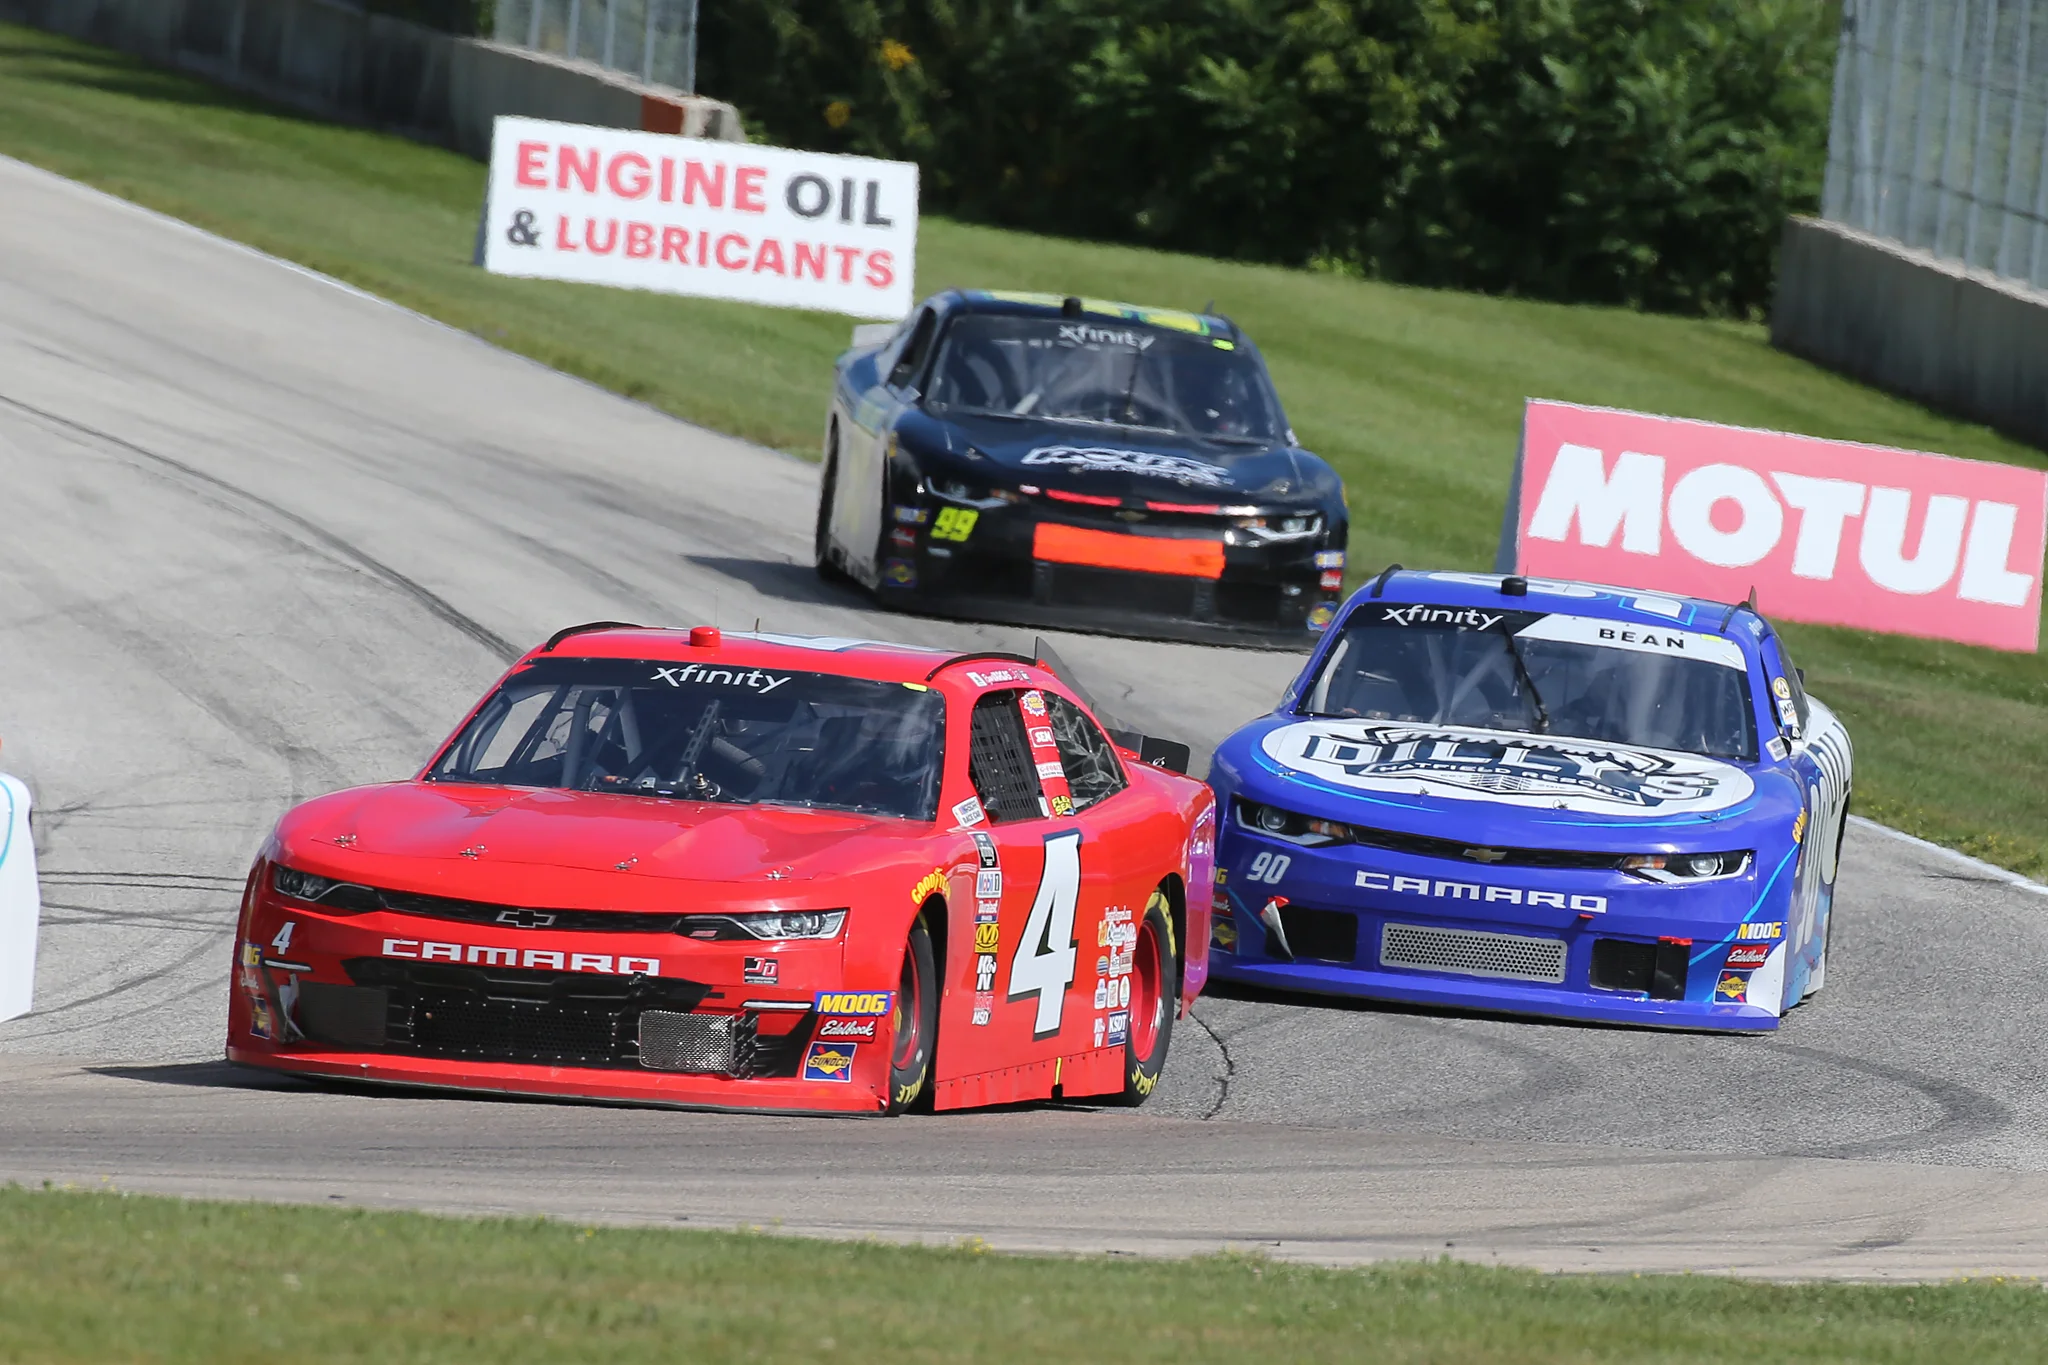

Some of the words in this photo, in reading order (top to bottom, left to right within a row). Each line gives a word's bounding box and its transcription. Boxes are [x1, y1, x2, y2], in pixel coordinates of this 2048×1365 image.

[515, 140, 767, 213] ENGINE
[786, 173, 894, 227] OIL
[506, 209, 541, 247] &
[556, 214, 895, 289] LUBRICANTS
[1058, 323, 1156, 351] xfinity
[930, 506, 980, 542] 99
[1527, 442, 2034, 607] MOTUL
[1381, 604, 1504, 631] xfinity
[1598, 627, 1686, 650] BEAN
[650, 663, 791, 694] xfinity
[1378, 762, 1512, 775] HATFIELD
[1521, 771, 1631, 798] RESORT
[1246, 851, 1292, 884] 90
[1354, 870, 1608, 914] CAMARO
[271, 921, 296, 955] 4
[1008, 830, 1081, 1034] 4
[1736, 921, 1783, 940] MOOG
[381, 938, 661, 977] CAMARO
[817, 993, 888, 1014] MOOG
[819, 1019, 875, 1037] Edelbrock
[809, 1056, 850, 1067] SUNOCO
